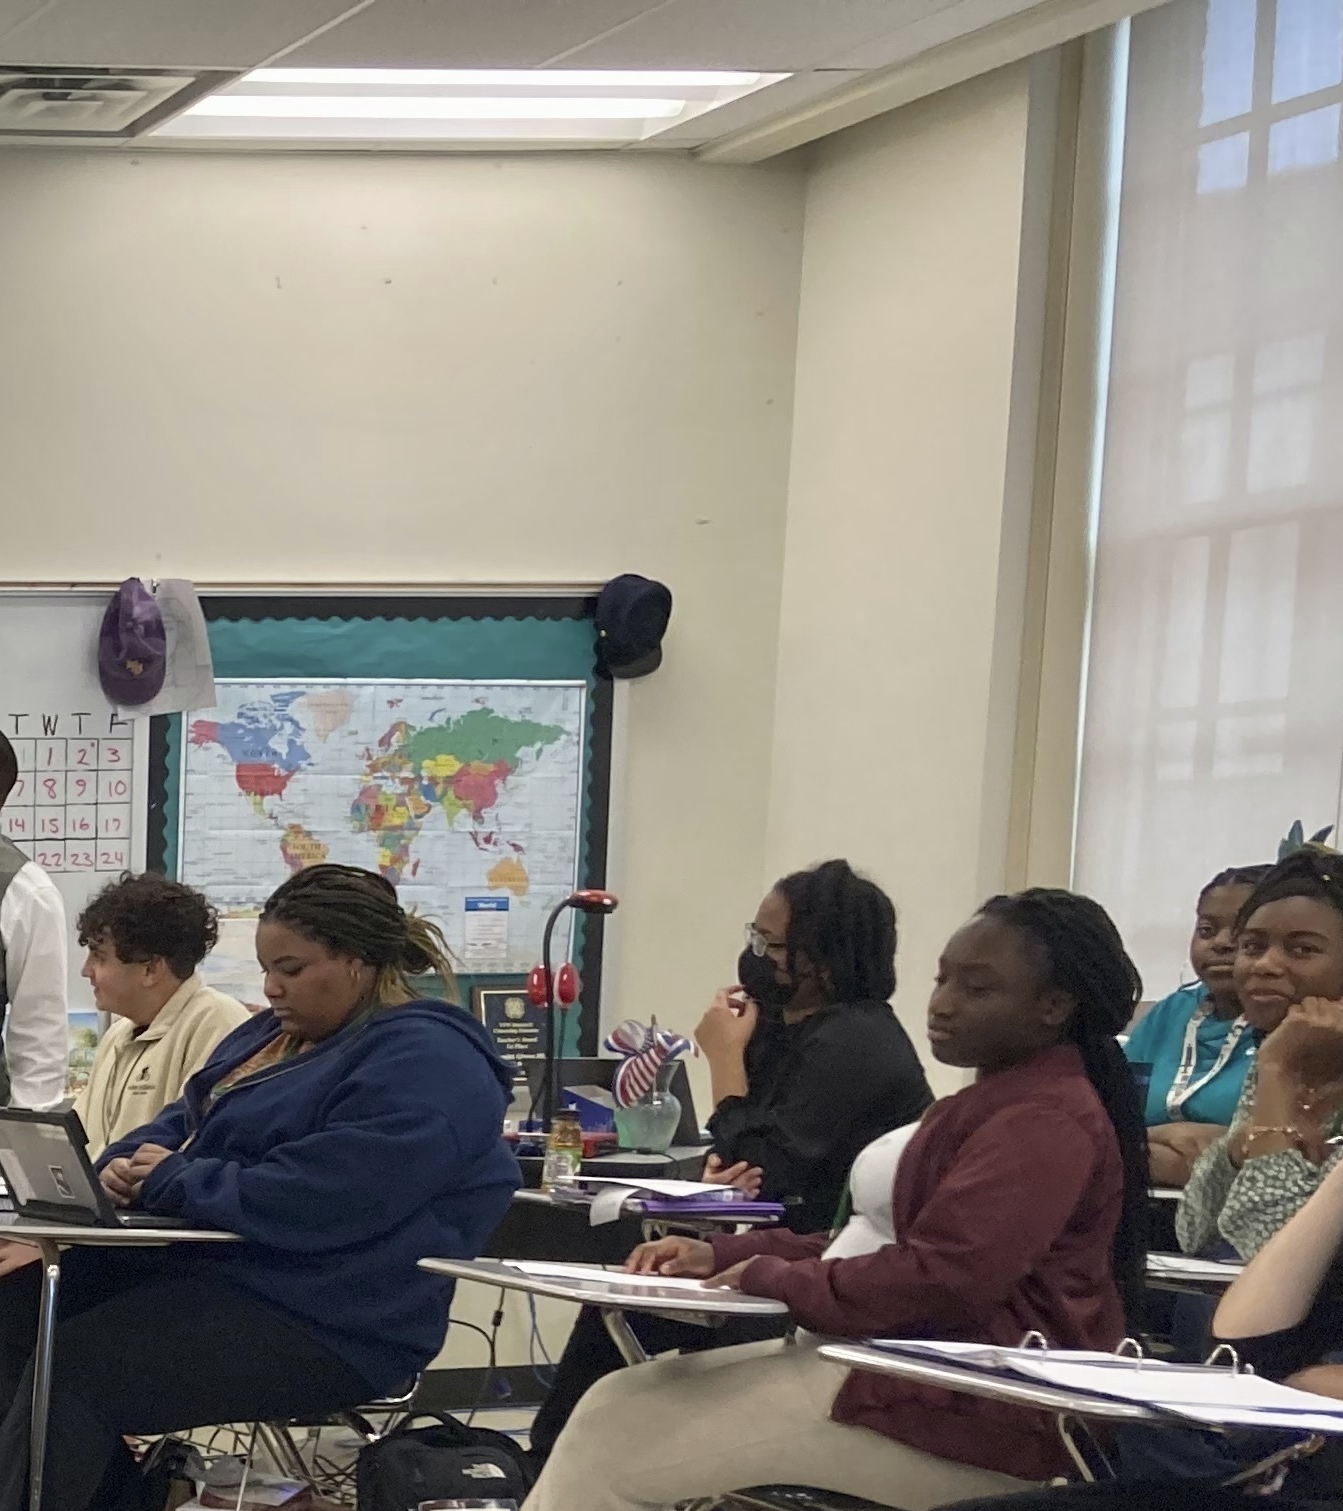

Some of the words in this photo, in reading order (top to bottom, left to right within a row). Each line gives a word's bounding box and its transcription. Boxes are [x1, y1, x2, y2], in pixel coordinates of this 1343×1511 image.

[8, 713, 30, 735] T
[42, 713, 59, 736] W
[71, 712, 92, 735] T
[77, 749, 91, 766] 2
[107, 748, 121, 763] 3
[42, 778, 57, 799] 8
[75, 779, 87, 797] 9
[108, 780, 127, 797] 10
[9, 818, 26, 833] 14
[42, 818, 59, 834] 15
[72, 818, 90, 831] 16
[105, 818, 121, 832] 17
[38, 852, 62, 867] 22
[71, 852, 94, 868] 23
[100, 852, 123, 865] 24
